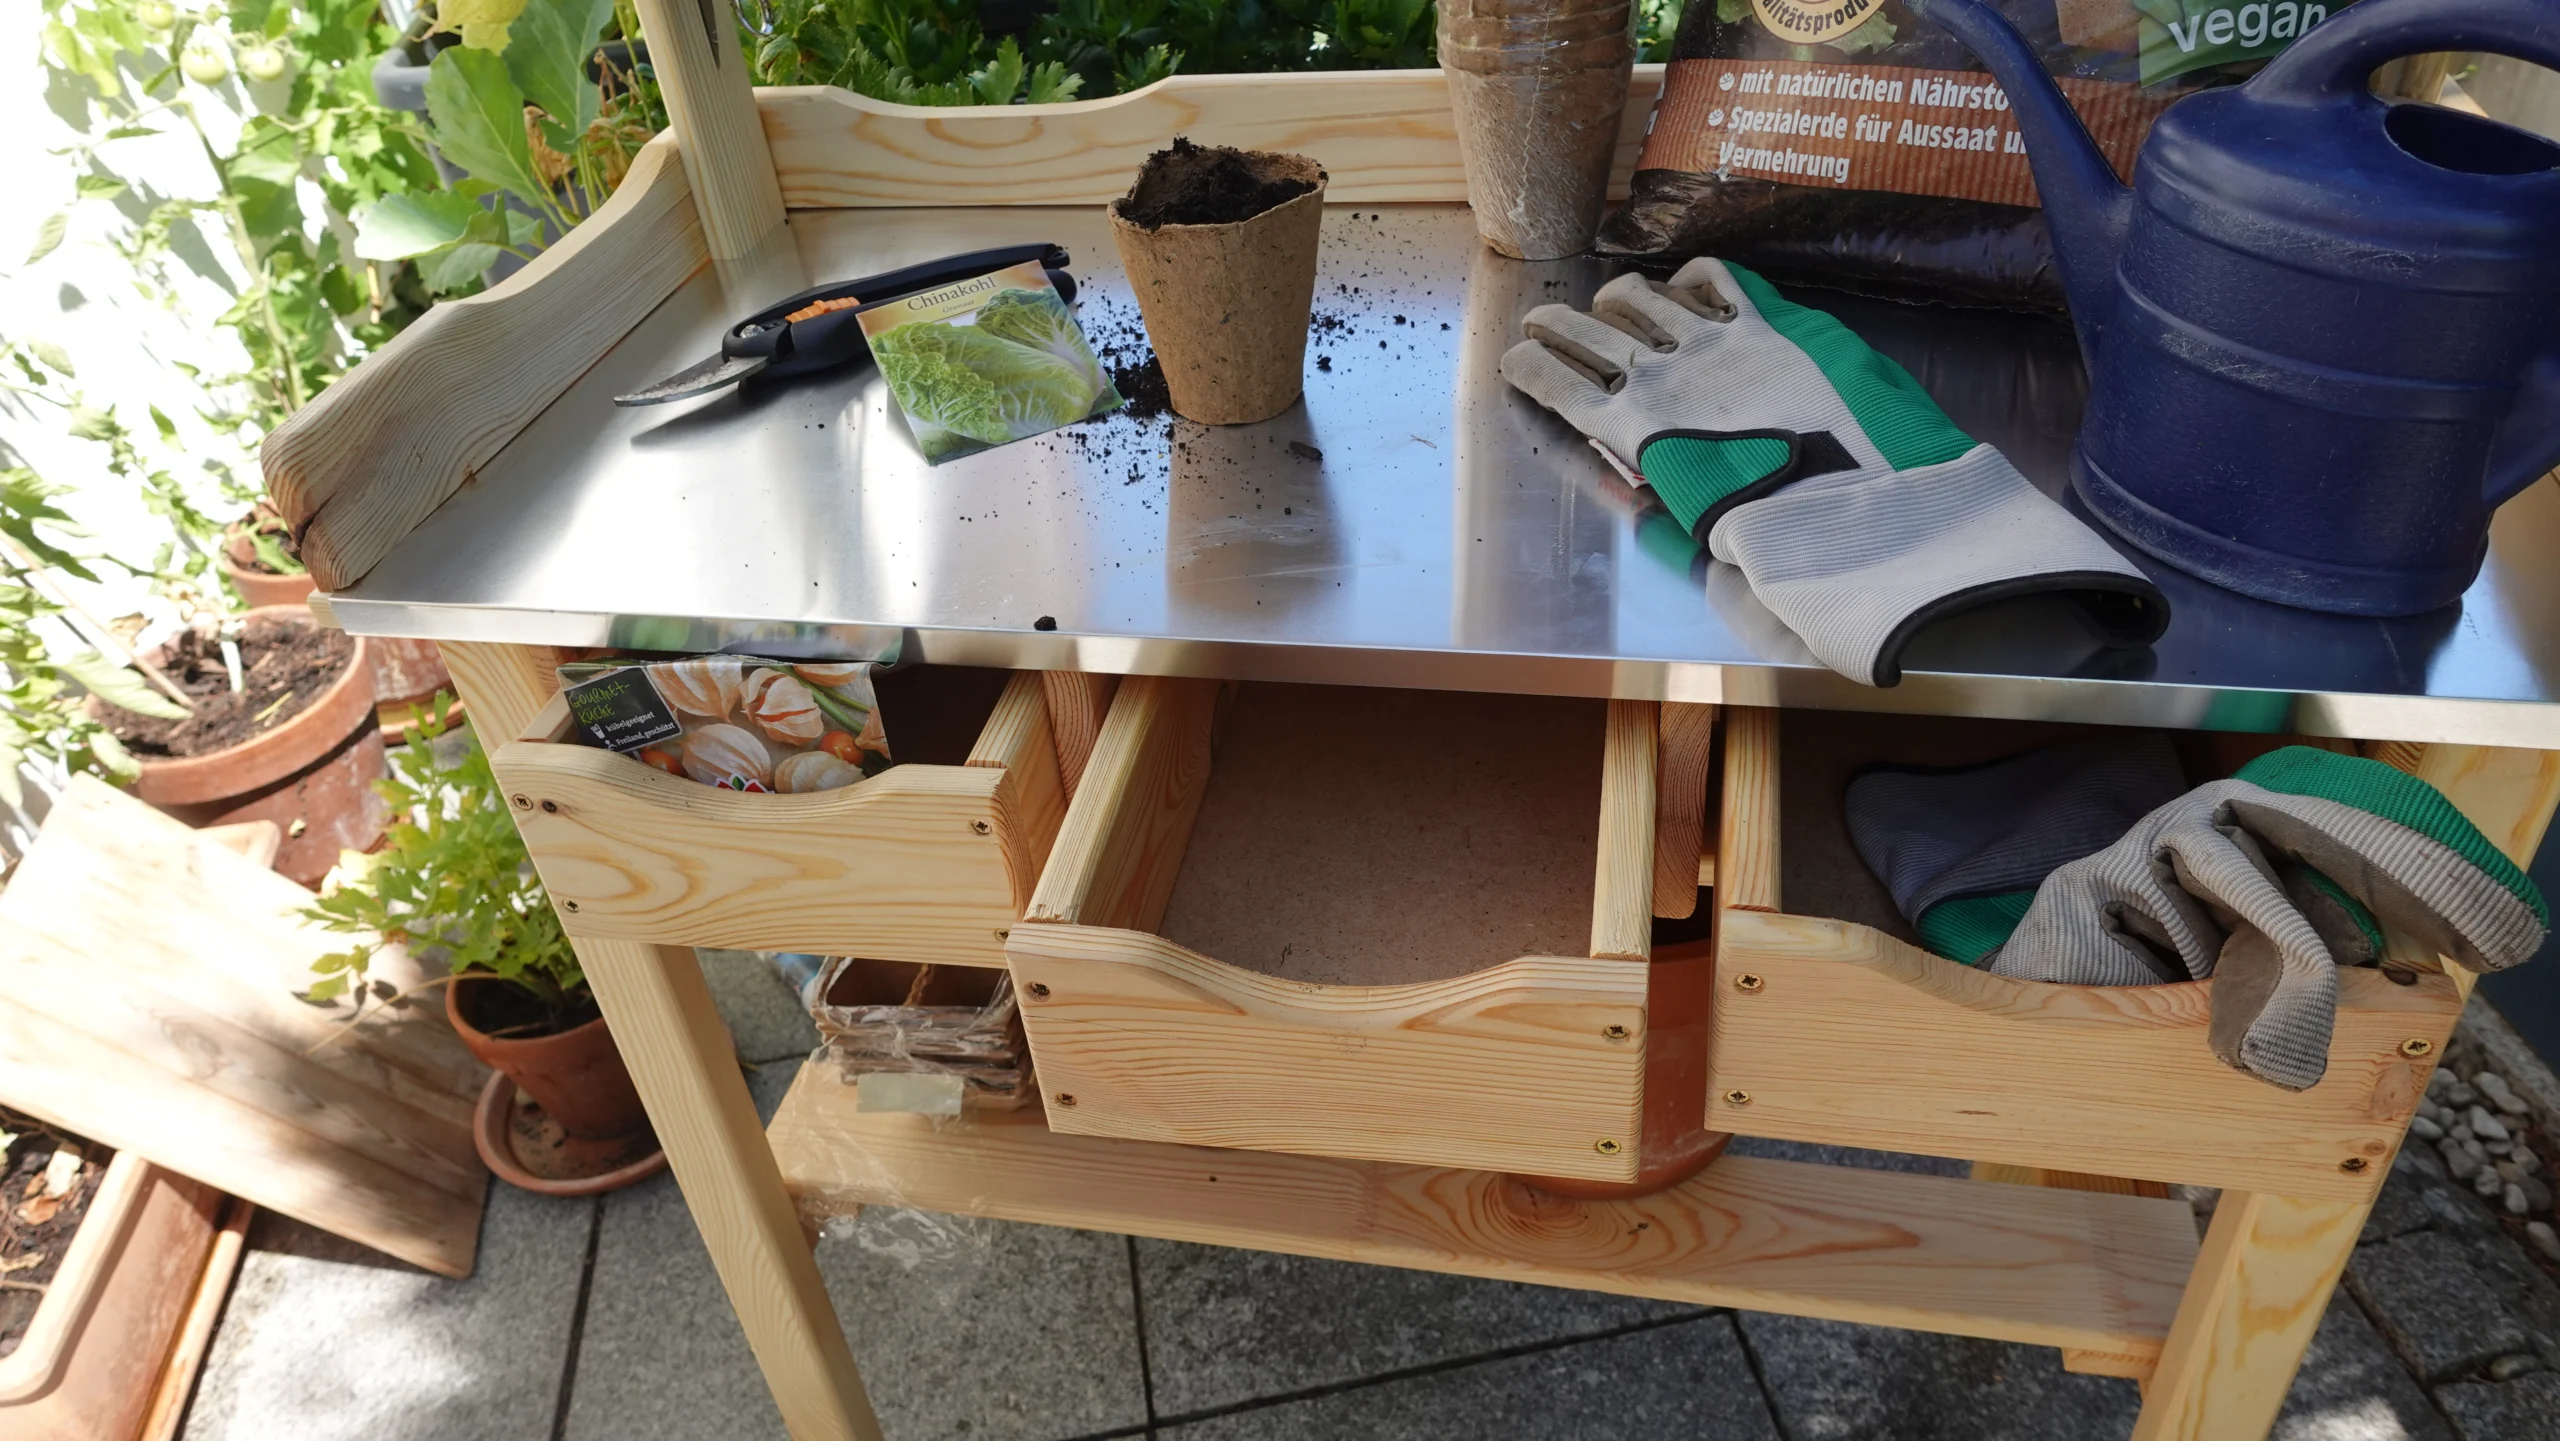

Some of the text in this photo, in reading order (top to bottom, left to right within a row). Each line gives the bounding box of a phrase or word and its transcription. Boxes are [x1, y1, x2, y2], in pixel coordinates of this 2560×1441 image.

[1763, 0, 1871, 35] alitätsprodu
[2167, 1, 2326, 53] vegan
[1739, 69, 2011, 111] mit natürlichen Nährsto
[1728, 106, 1848, 139] Spezialerde
[1855, 114, 1892, 142] für
[1897, 120, 1997, 152] Aussaat
[1719, 141, 1849, 183] Vermehrung
[908, 276, 996, 310] Chinakohl
[605, 711, 655, 732] kübelgeeignet
